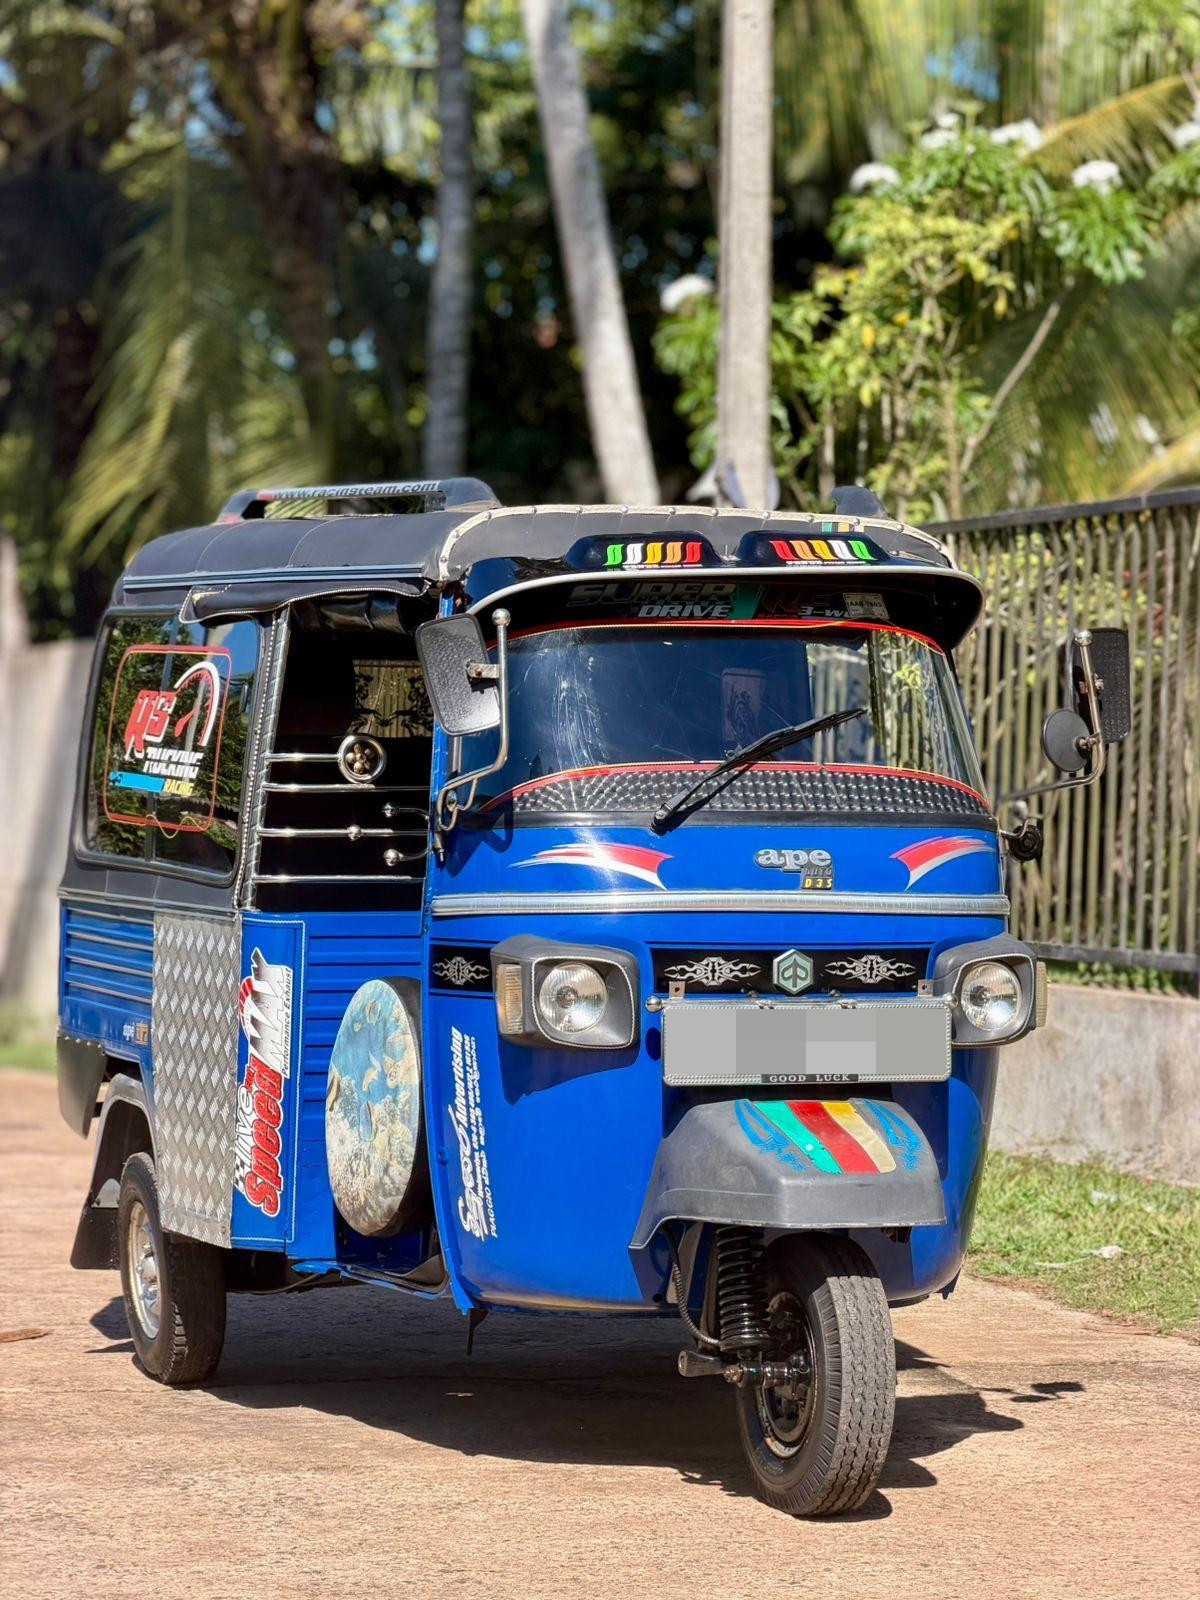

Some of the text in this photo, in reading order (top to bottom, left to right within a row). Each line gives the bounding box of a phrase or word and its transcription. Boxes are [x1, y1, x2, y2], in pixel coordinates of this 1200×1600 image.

[637, 604, 731, 618] DRIVE
[163, 777, 195, 798] RACING
[756, 848, 832, 870] ape
[281, 967, 292, 1077] Performance Exhaust
[451, 1025, 468, 1128] Advertising
[769, 1073, 851, 1083] GOOD LUCK
[244, 1054, 283, 1215] Speed
[484, 1186, 498, 1238] PIAGGIO
